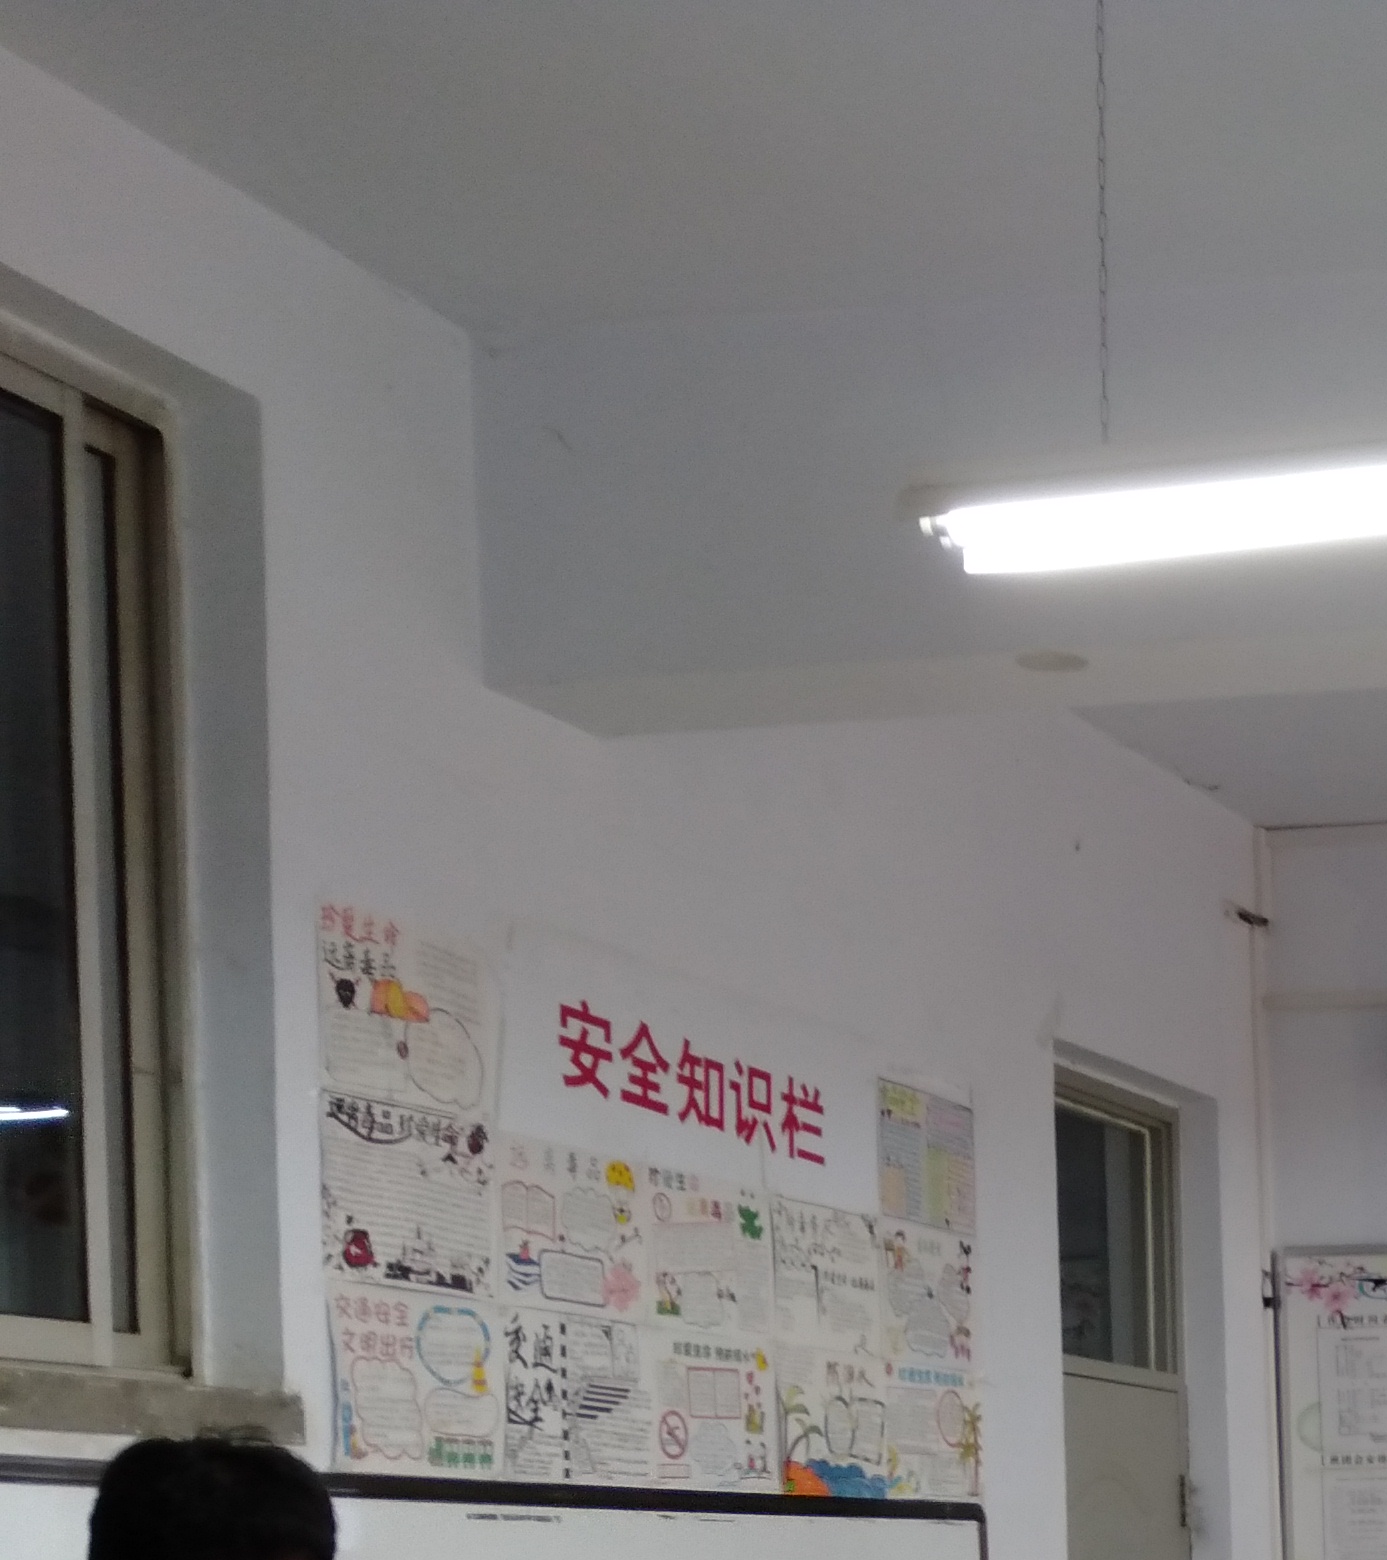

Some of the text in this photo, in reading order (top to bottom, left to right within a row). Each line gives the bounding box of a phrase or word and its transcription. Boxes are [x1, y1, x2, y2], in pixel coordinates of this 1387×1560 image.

[558, 1000, 826, 1166] 安全知识栏
